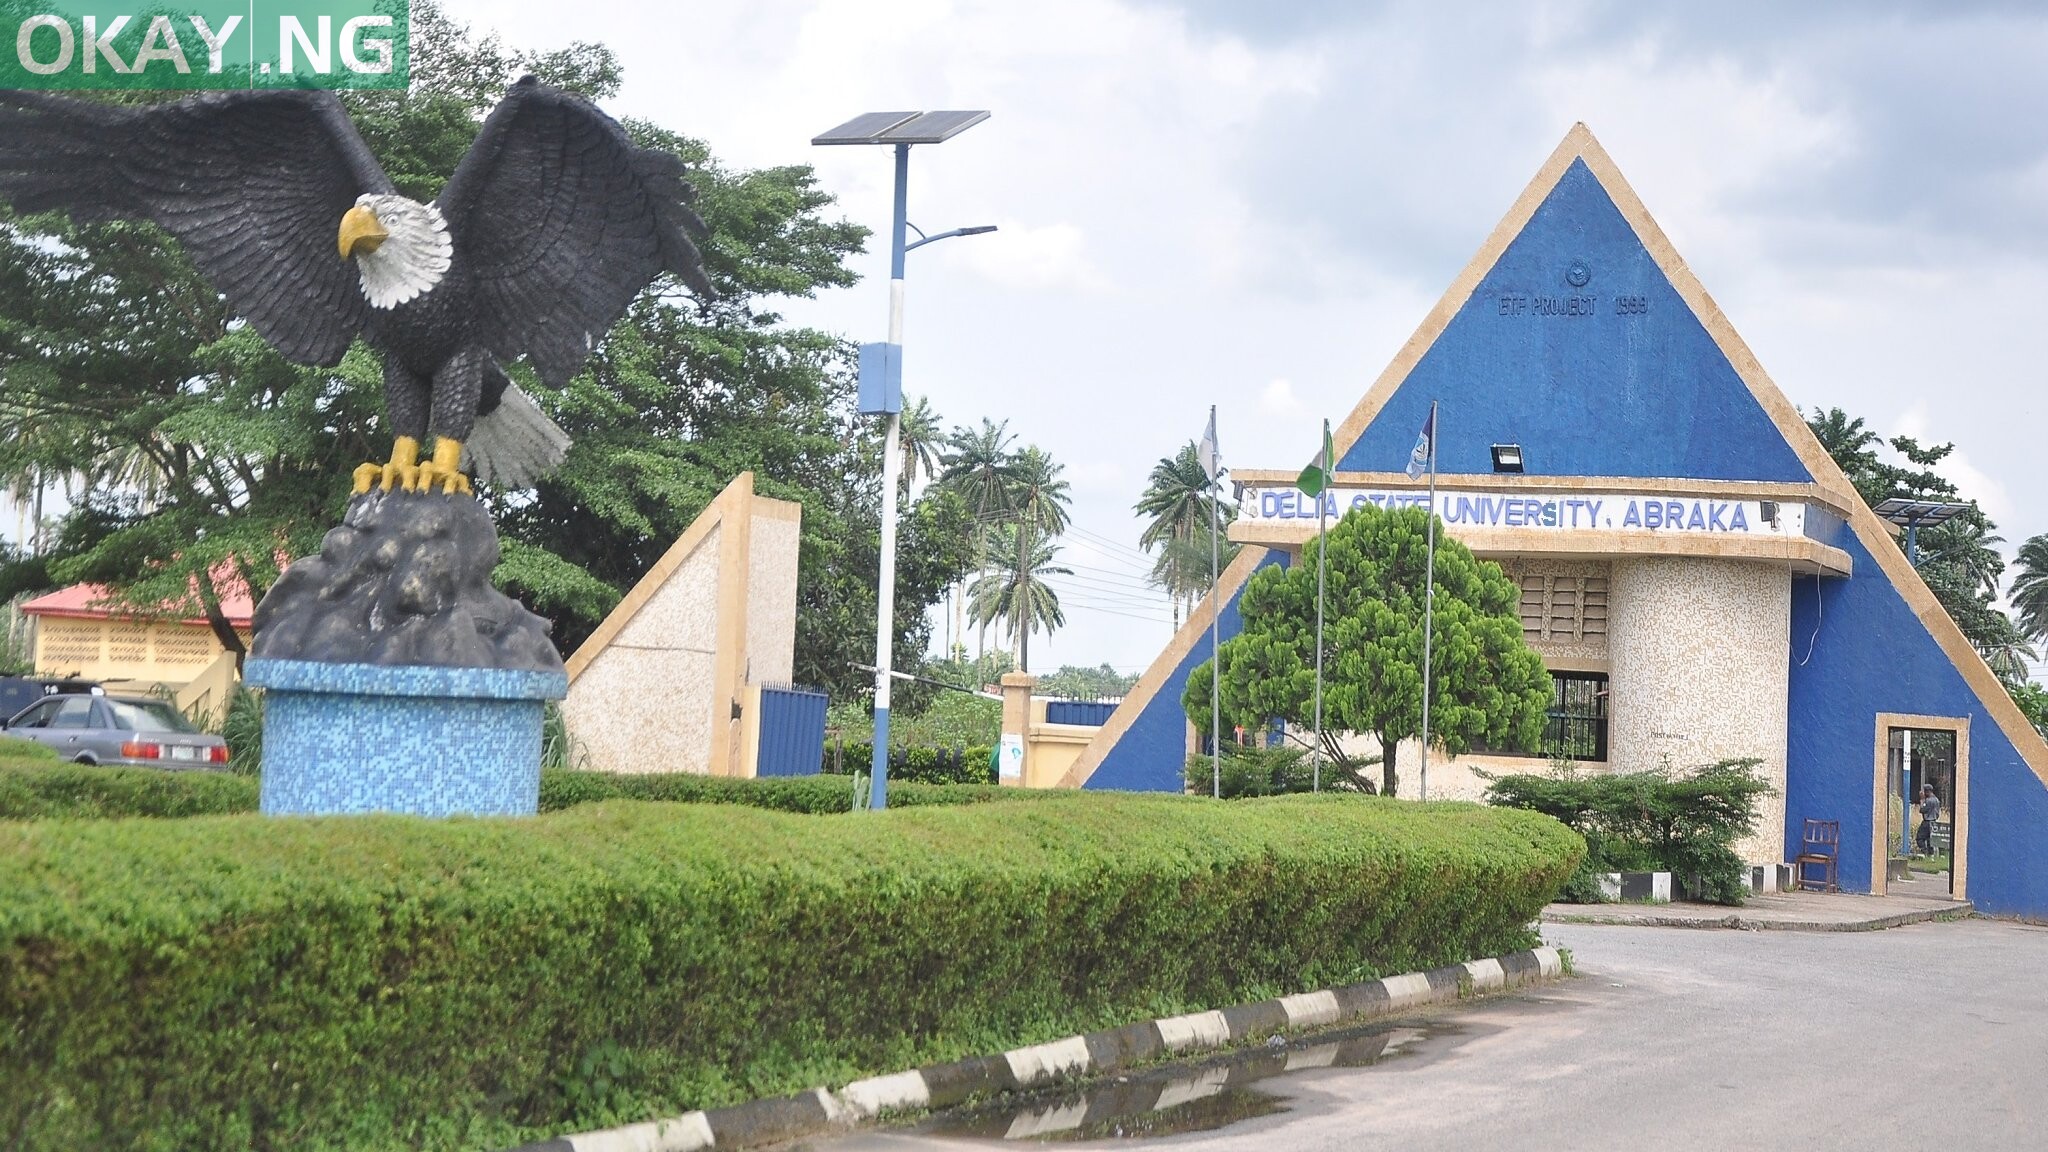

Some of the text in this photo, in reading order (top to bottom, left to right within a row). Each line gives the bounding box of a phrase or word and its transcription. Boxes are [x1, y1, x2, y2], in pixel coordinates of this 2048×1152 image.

[1499, 298, 1649, 315] ETF PROJECT 1999
[1623, 500, 1749, 532] ABRAKA
